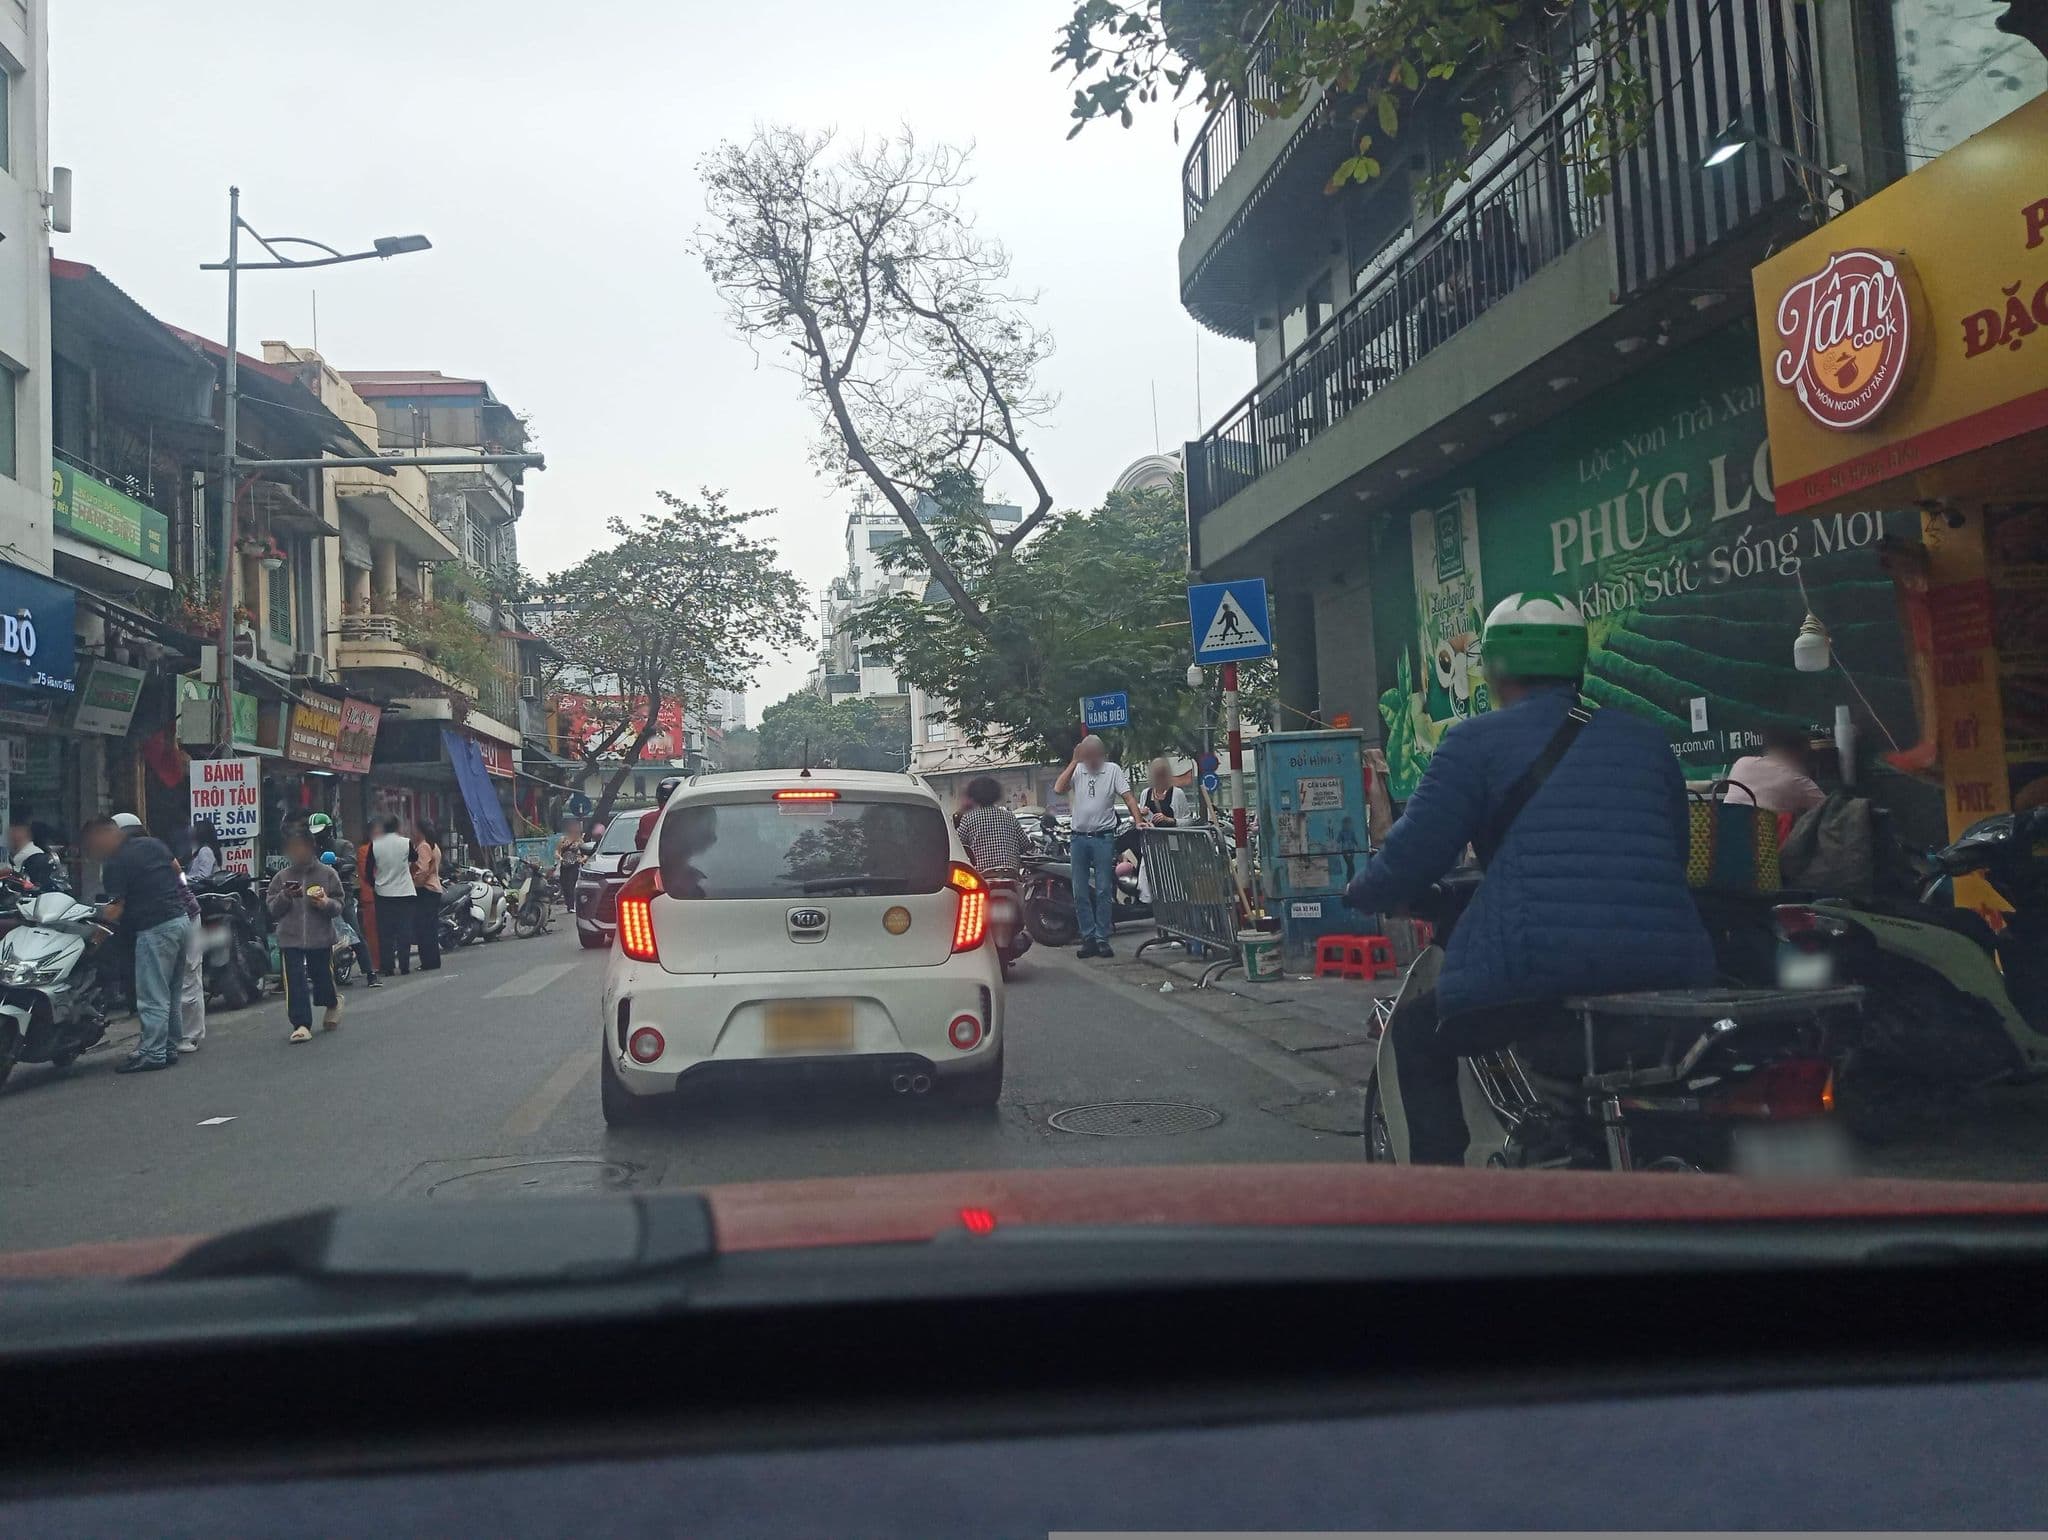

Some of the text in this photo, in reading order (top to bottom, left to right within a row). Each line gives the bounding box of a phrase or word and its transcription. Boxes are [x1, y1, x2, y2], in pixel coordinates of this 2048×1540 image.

[1853, 316, 1897, 349] COOK
[1835, 399, 1861, 411] NGON
[1622, 426, 1667, 464] Non
[1550, 467, 1693, 576] PHÚC
[3, 608, 36, 667] BỘ
[37, 671, 46, 686] 75
[1088, 710, 1108, 724] HÀNG
[203, 760, 243, 782] BÁNH
[192, 785, 225, 808] TRÔI
[216, 826, 247, 838] ÓNG
